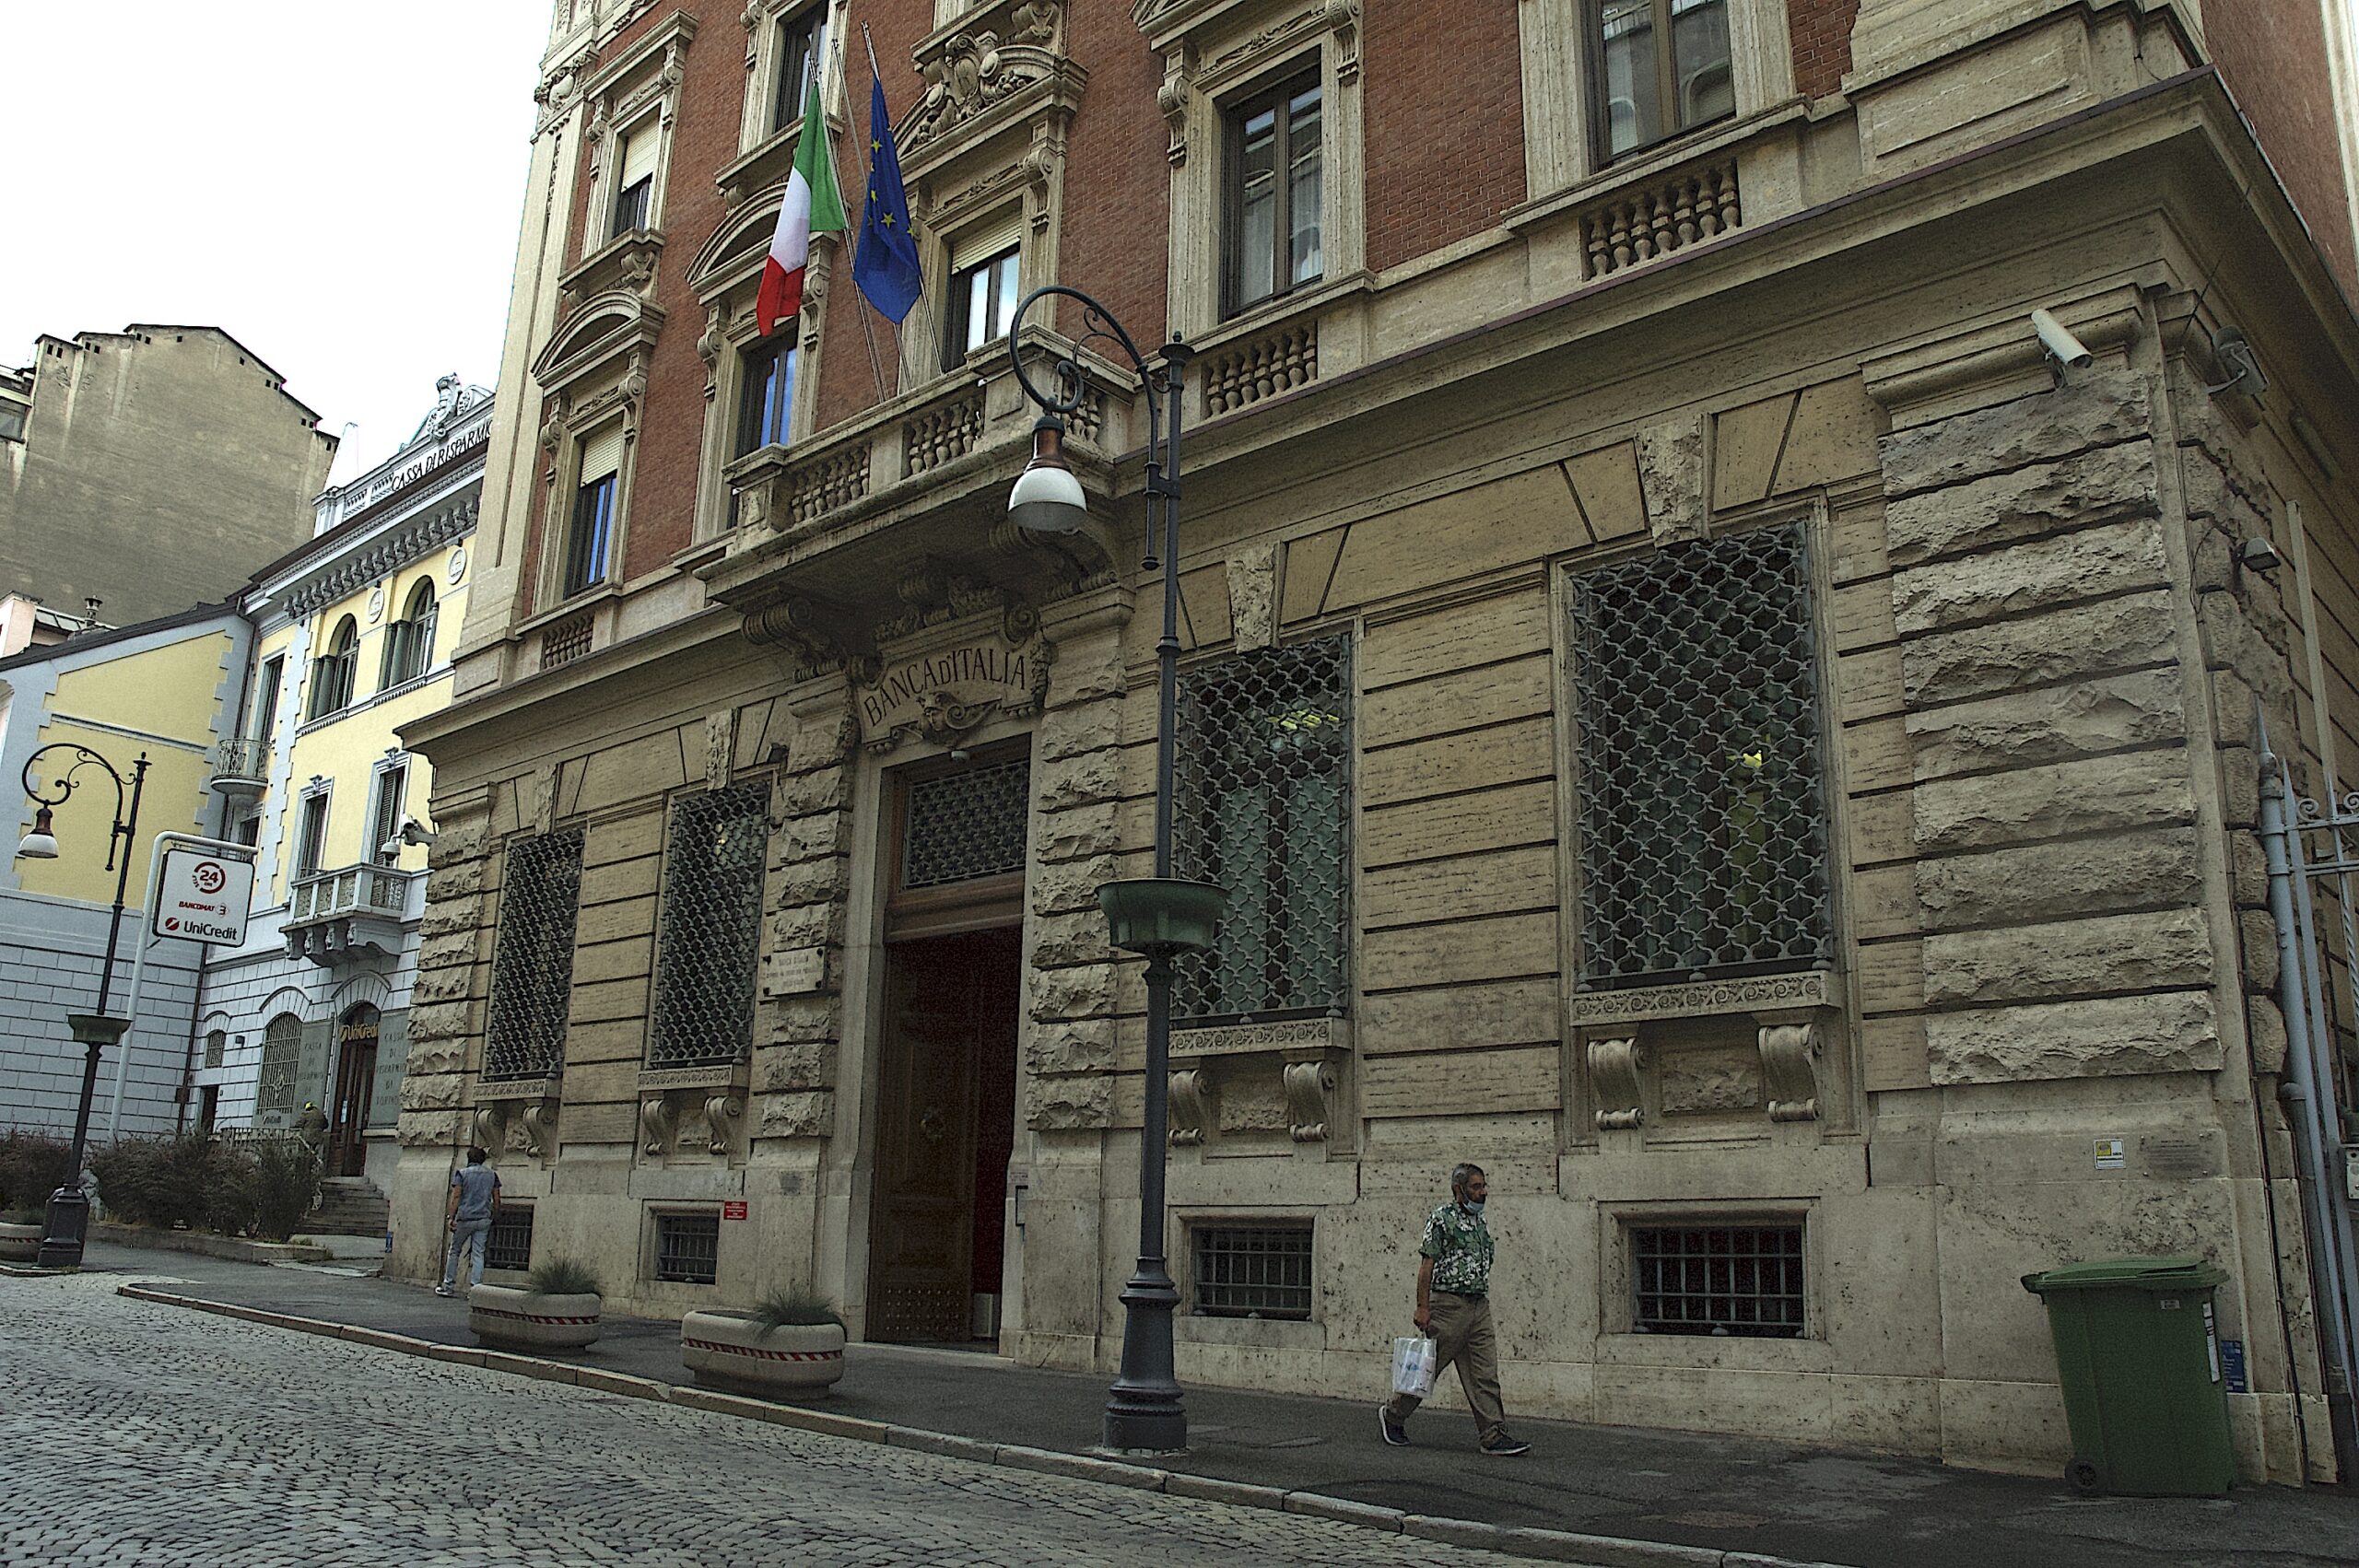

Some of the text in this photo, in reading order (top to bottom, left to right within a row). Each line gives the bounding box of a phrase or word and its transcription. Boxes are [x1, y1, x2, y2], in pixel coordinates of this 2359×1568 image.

[392, 462, 423, 491] CASSA
[426, 452, 437, 474] DI
[863, 659, 939, 727] BANCA
[199, 870, 218, 883] 24
[184, 920, 237, 940] UniCredit
